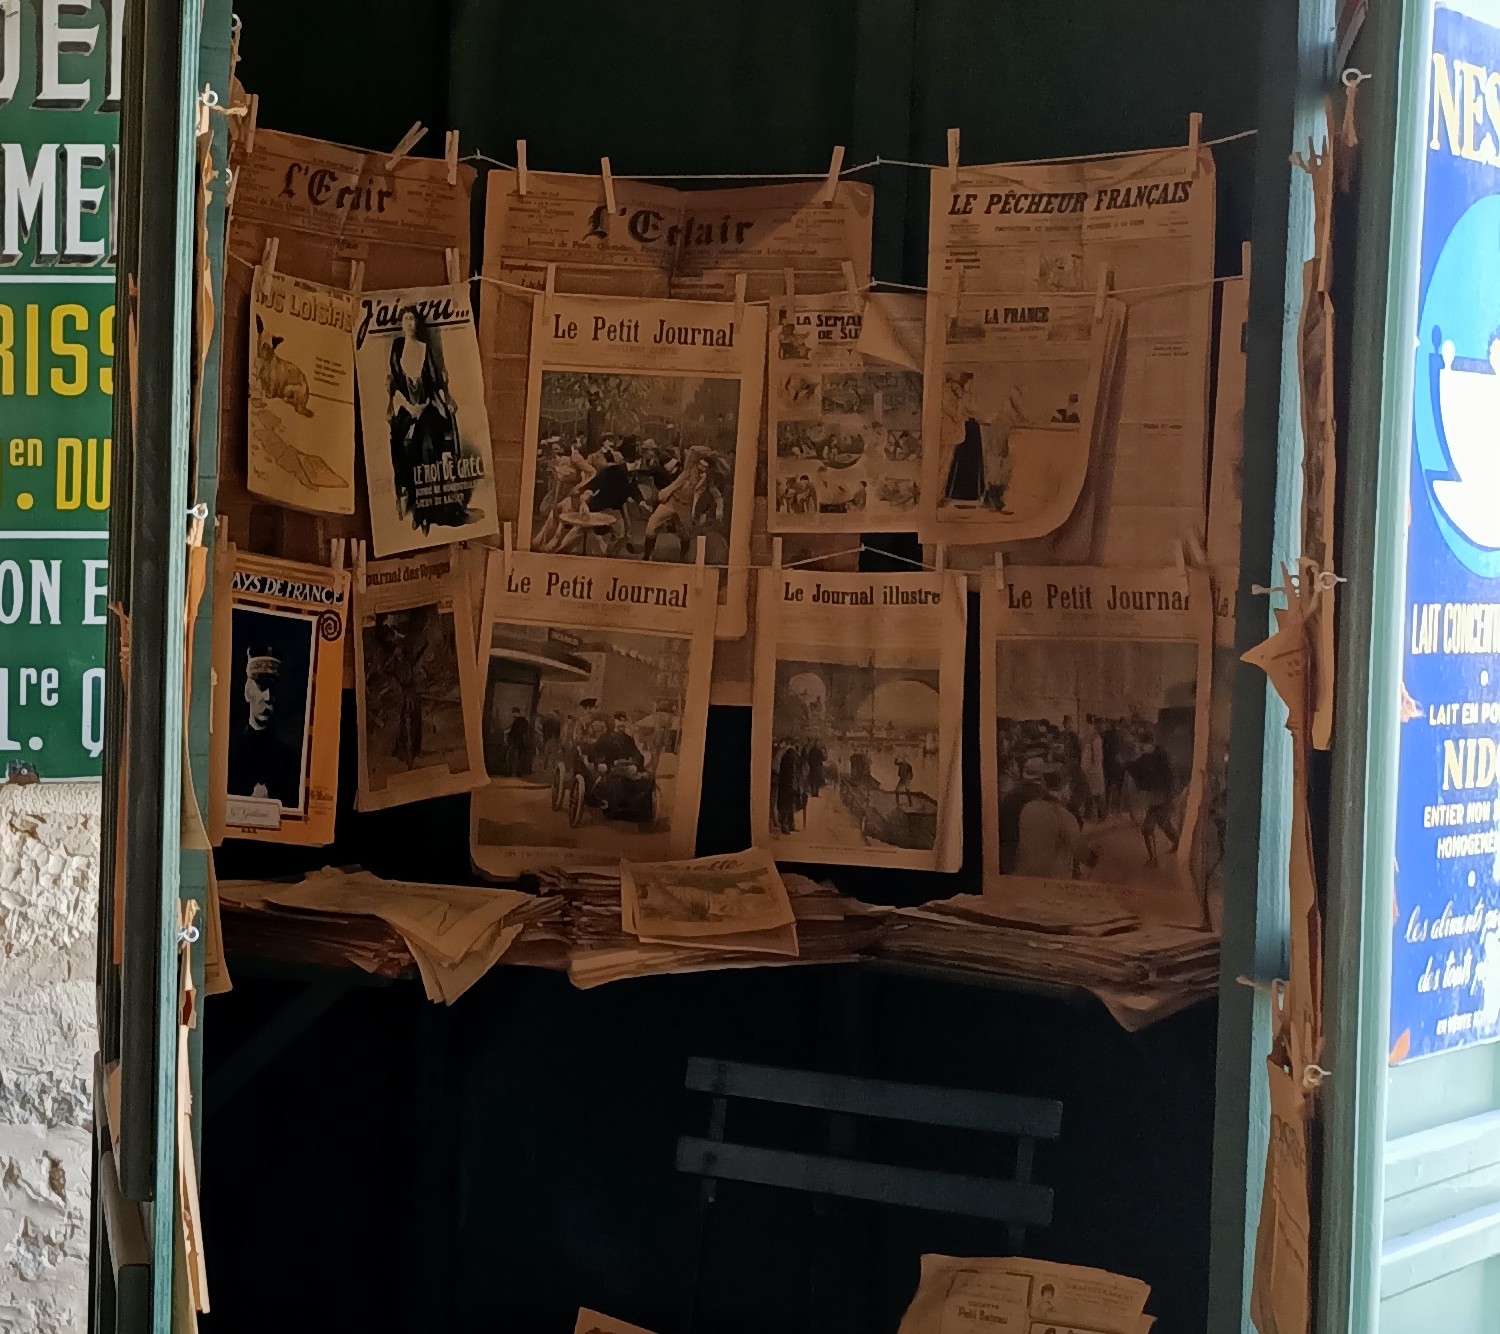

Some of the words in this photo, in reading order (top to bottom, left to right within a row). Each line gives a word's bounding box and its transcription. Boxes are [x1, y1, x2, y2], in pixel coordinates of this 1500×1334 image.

[948, 193, 978, 216] LE
[985, 189, 1088, 215] PÊCHEUR
[1094, 181, 1193, 212] FRANÇAIS
[984, 307, 1001, 324] LA
[1004, 306, 1050, 324] FRANCE
[553, 314, 577, 339] Le
[592, 316, 640, 342] Petit
[654, 319, 734, 347] Journal
[817, 328, 835, 340] DE
[366, 567, 401, 586] ournal
[506, 571, 531, 593] Le
[546, 572, 593, 599] Petit
[606, 577, 688, 608] Journal
[784, 581, 804, 601] Le
[812, 583, 874, 605] Journal
[1008, 583, 1032, 609] Le
[1046, 584, 1093, 610] Petit
[1411, 603, 1441, 655] LAIT
[1429, 702, 1460, 726] LAIT
[1442, 737, 1500, 791] NID
[1423, 804, 1464, 828] ENTIER
